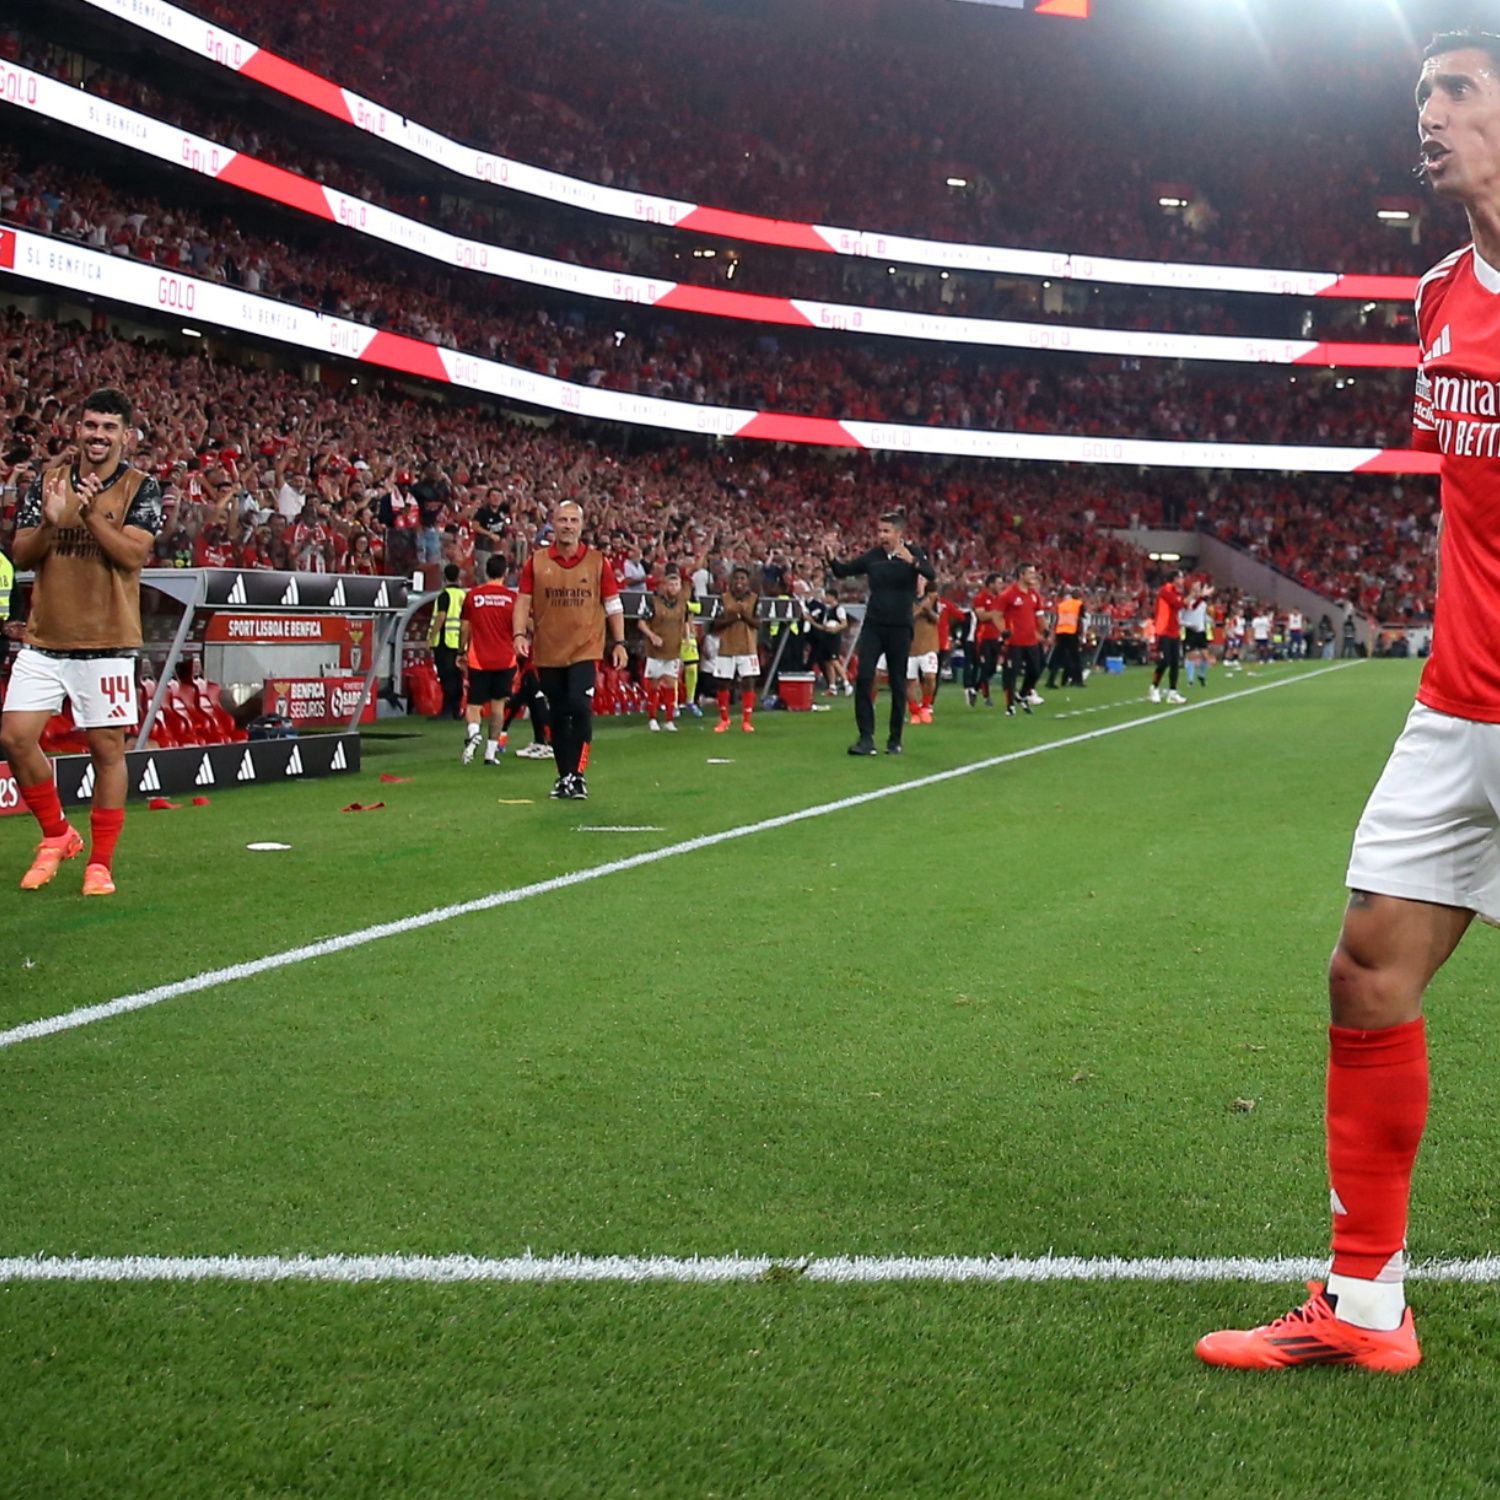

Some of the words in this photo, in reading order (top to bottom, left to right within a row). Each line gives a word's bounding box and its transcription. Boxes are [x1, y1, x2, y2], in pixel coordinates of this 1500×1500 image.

[26, 246, 41, 267] SL
[49, 252, 103, 281] BENFICA
[157, 275, 197, 314] GOLO
[241, 303, 253, 321] SL
[257, 307, 298, 332] BENFICA
[228, 620, 255, 636] SPORT
[255, 620, 284, 637] LISBOA
[284, 620, 290, 637] E
[290, 620, 322, 637] BENFICA
[100, 675, 130, 704] 44
[290, 681, 325, 699] BENFICA
[290, 700, 325, 718] SEGUROS
